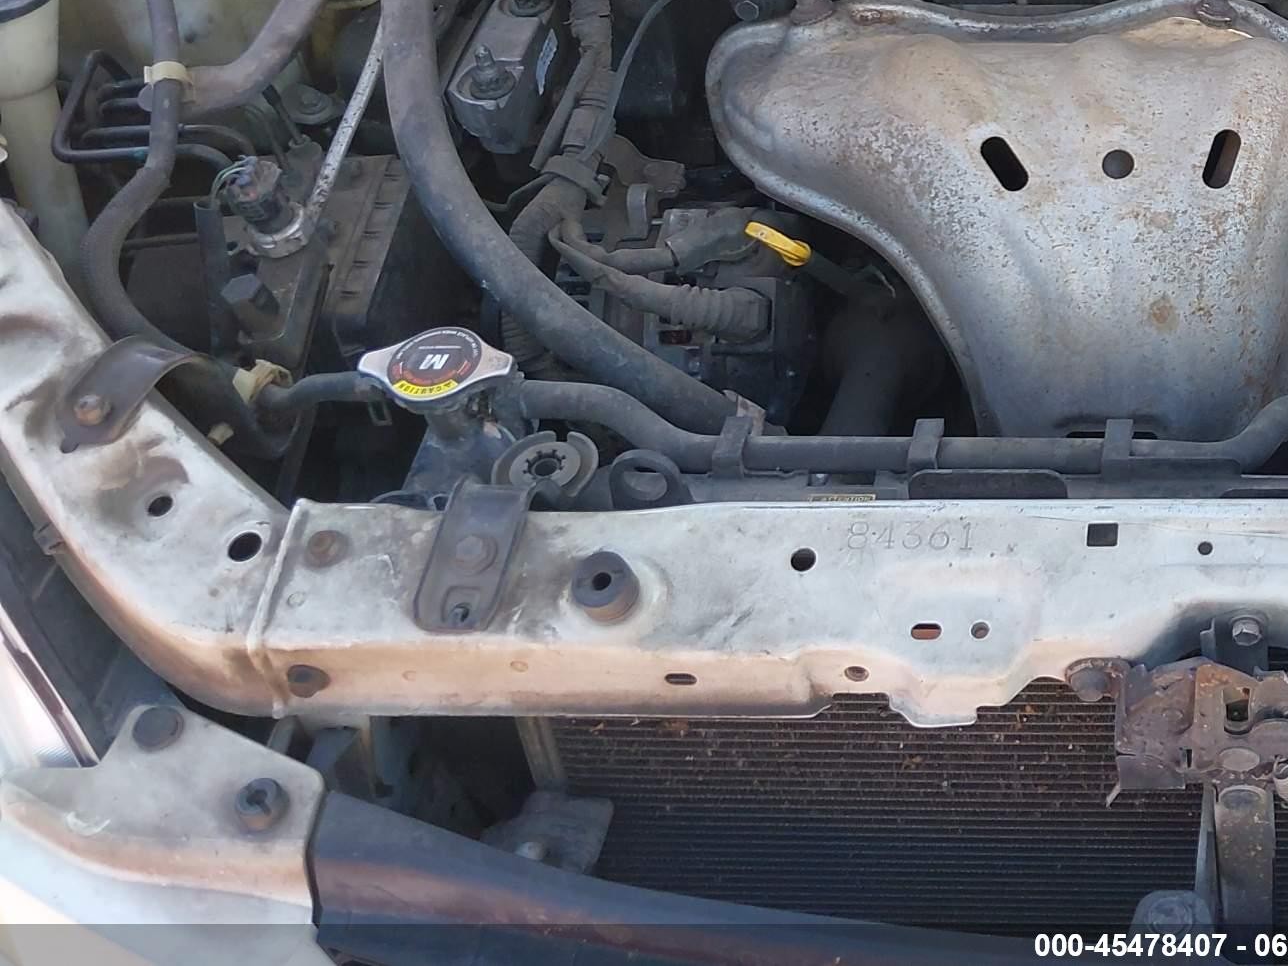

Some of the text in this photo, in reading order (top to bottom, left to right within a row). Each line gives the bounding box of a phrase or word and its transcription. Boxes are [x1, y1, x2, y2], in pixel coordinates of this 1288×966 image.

[418, 353, 450, 370] M
[398, 382, 442, 395] CAUTION
[847, 520, 974, 551] 84361
